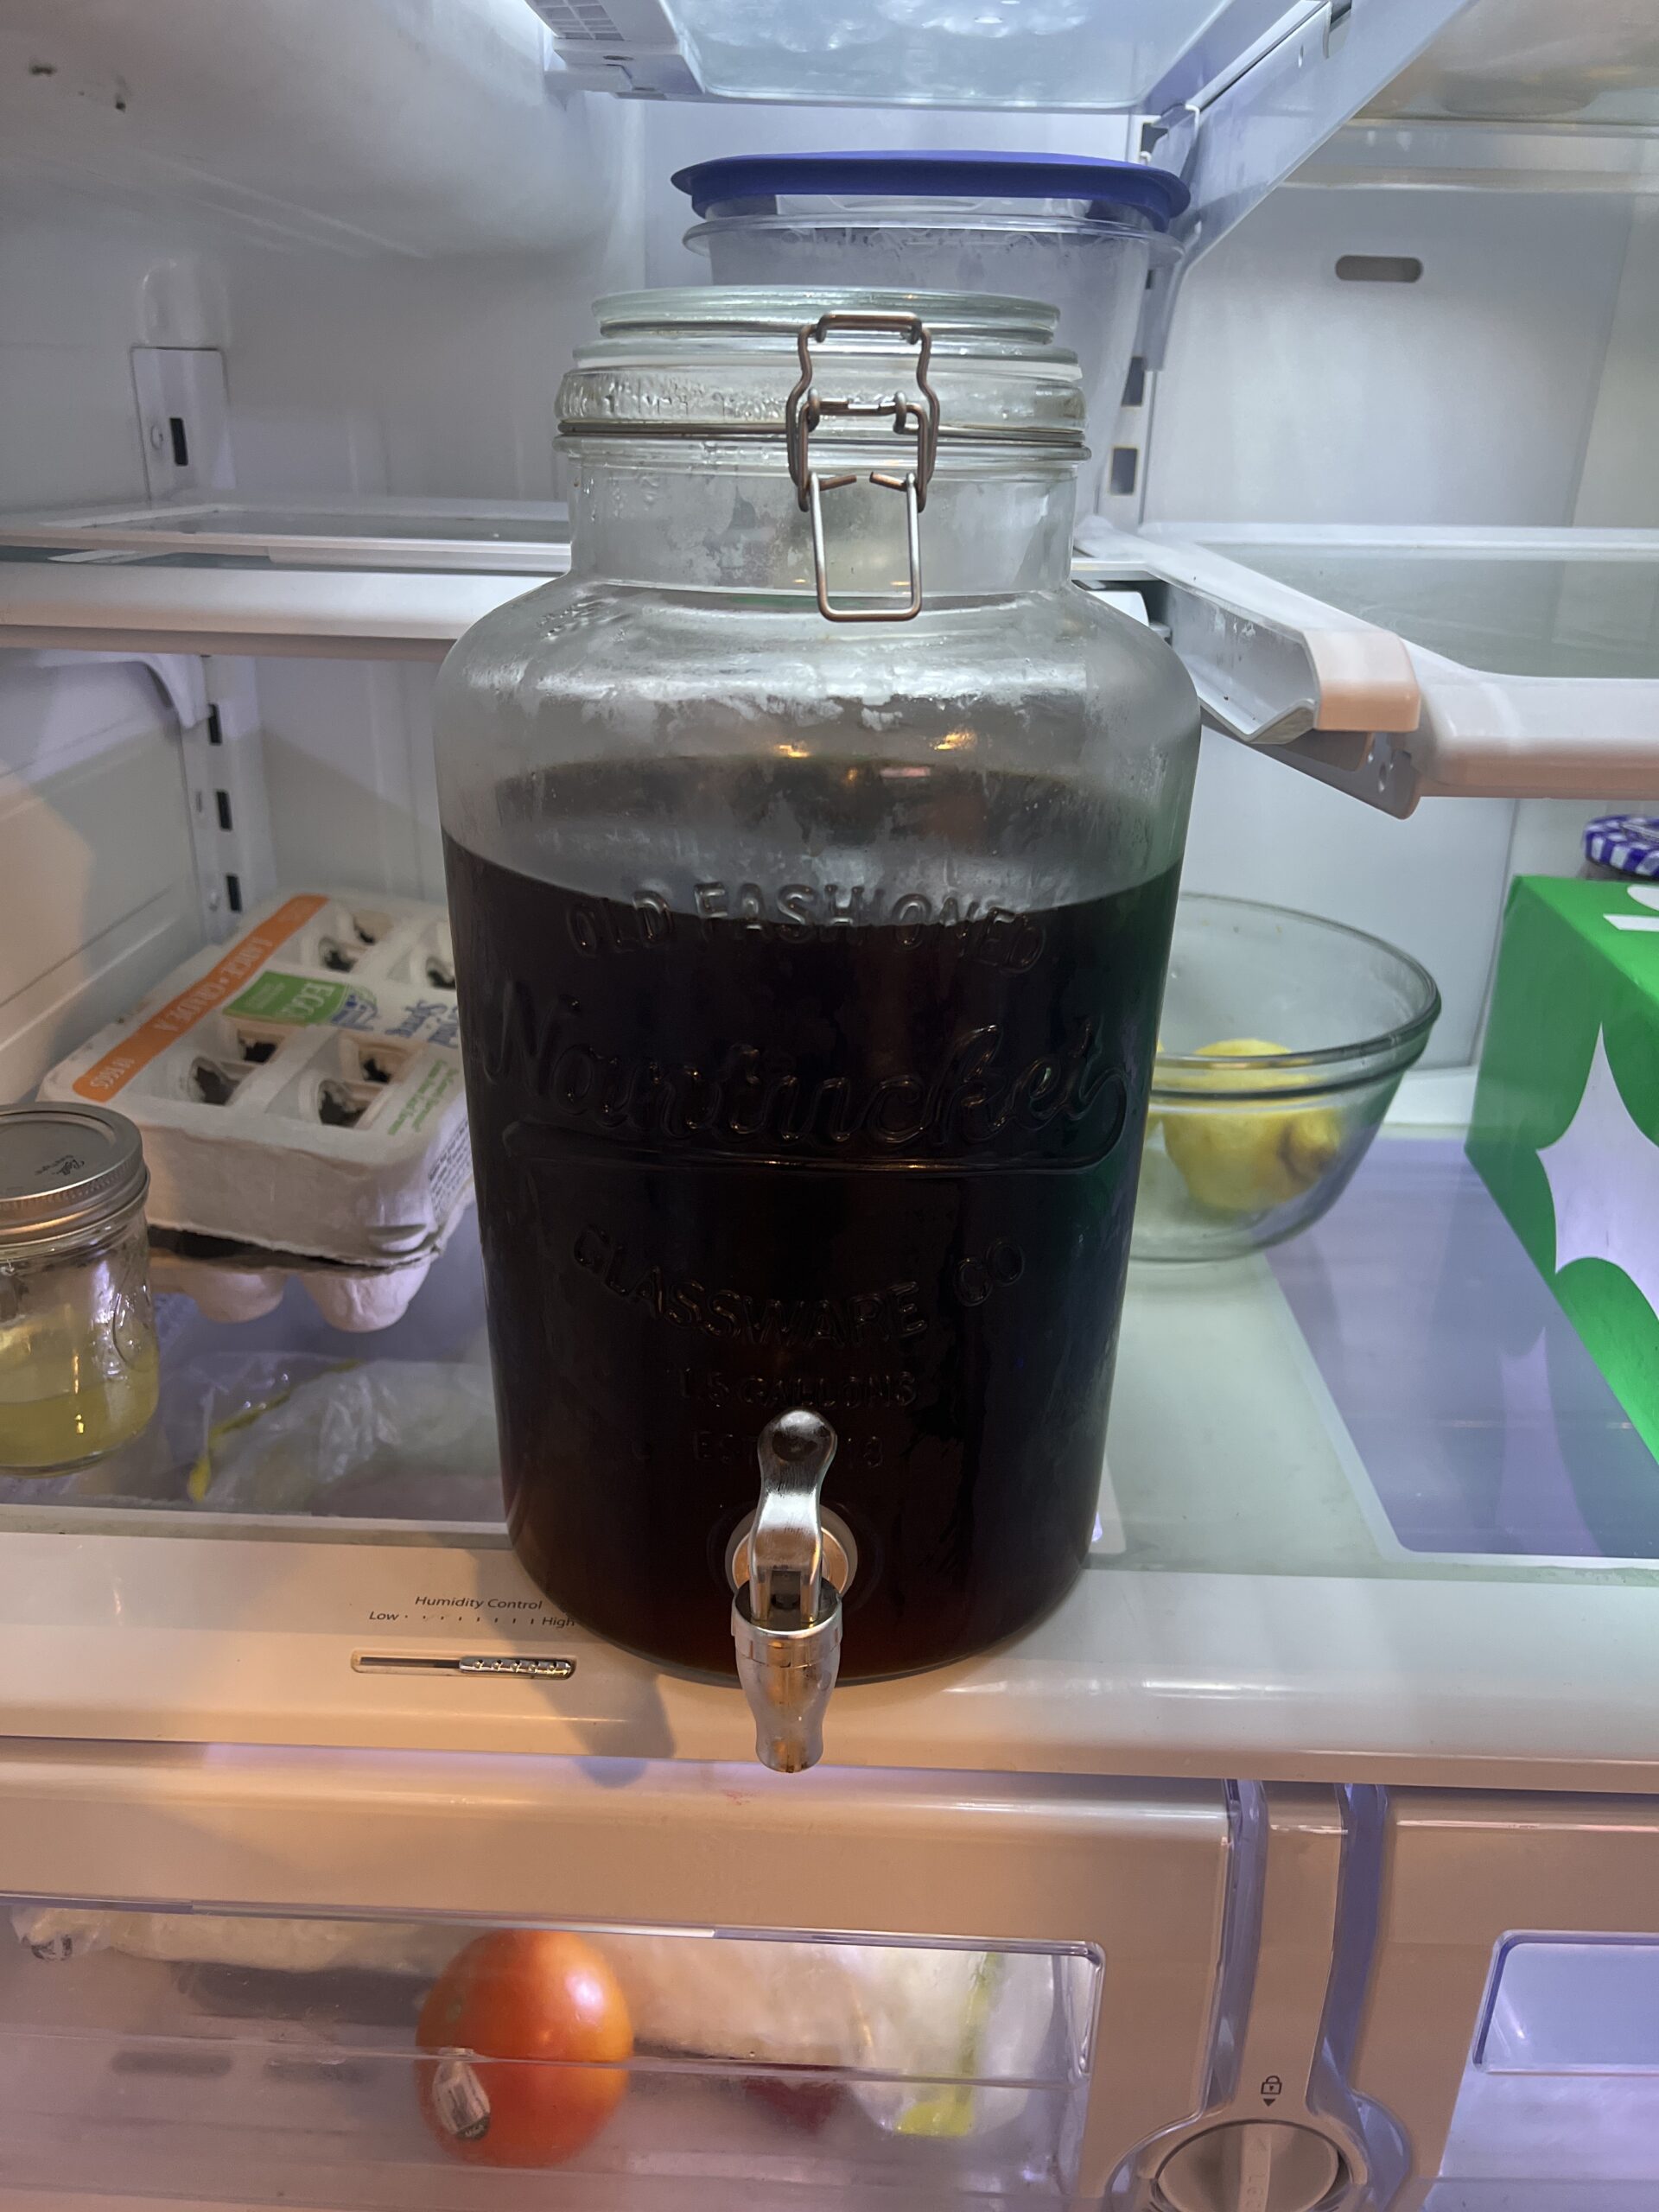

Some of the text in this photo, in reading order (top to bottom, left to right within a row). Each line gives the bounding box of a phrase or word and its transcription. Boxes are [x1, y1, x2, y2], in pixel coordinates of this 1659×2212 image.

[564, 882, 1046, 976] OLD FASHIONED
[467, 976, 1127, 1158] Nantucket
[573, 1222, 1025, 1350] GLASSWARE CO
[736, 1370, 918, 1410] GALLONS
[369, 1611, 575, 1629] Low High
[415, 1596, 543, 1610] Humidity Control
